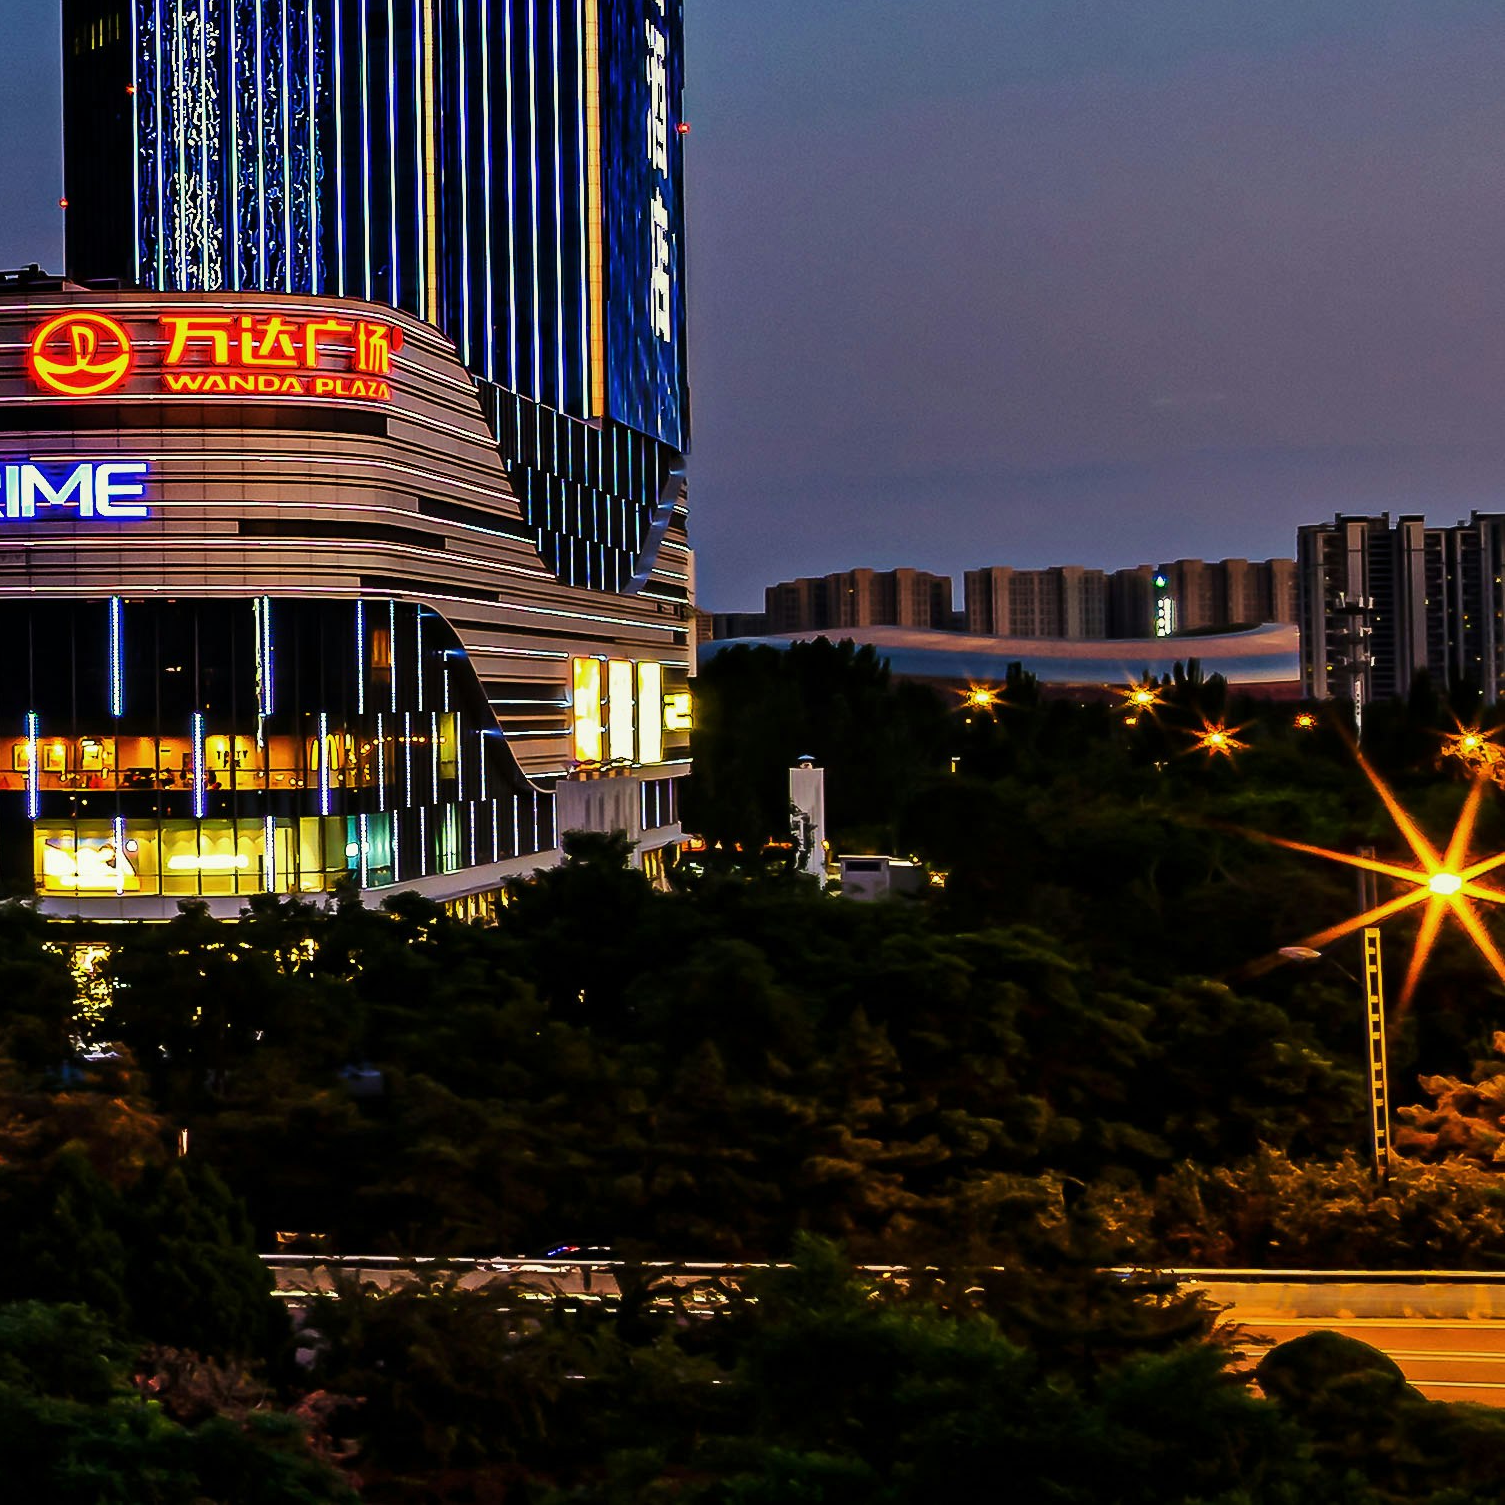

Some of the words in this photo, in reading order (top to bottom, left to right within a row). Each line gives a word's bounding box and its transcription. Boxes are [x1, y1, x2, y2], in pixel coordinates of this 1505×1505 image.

[160, 315, 388, 373] 万达广场
[166, 375, 302, 392] WANDA
[315, 378, 389, 400] PLAZA
